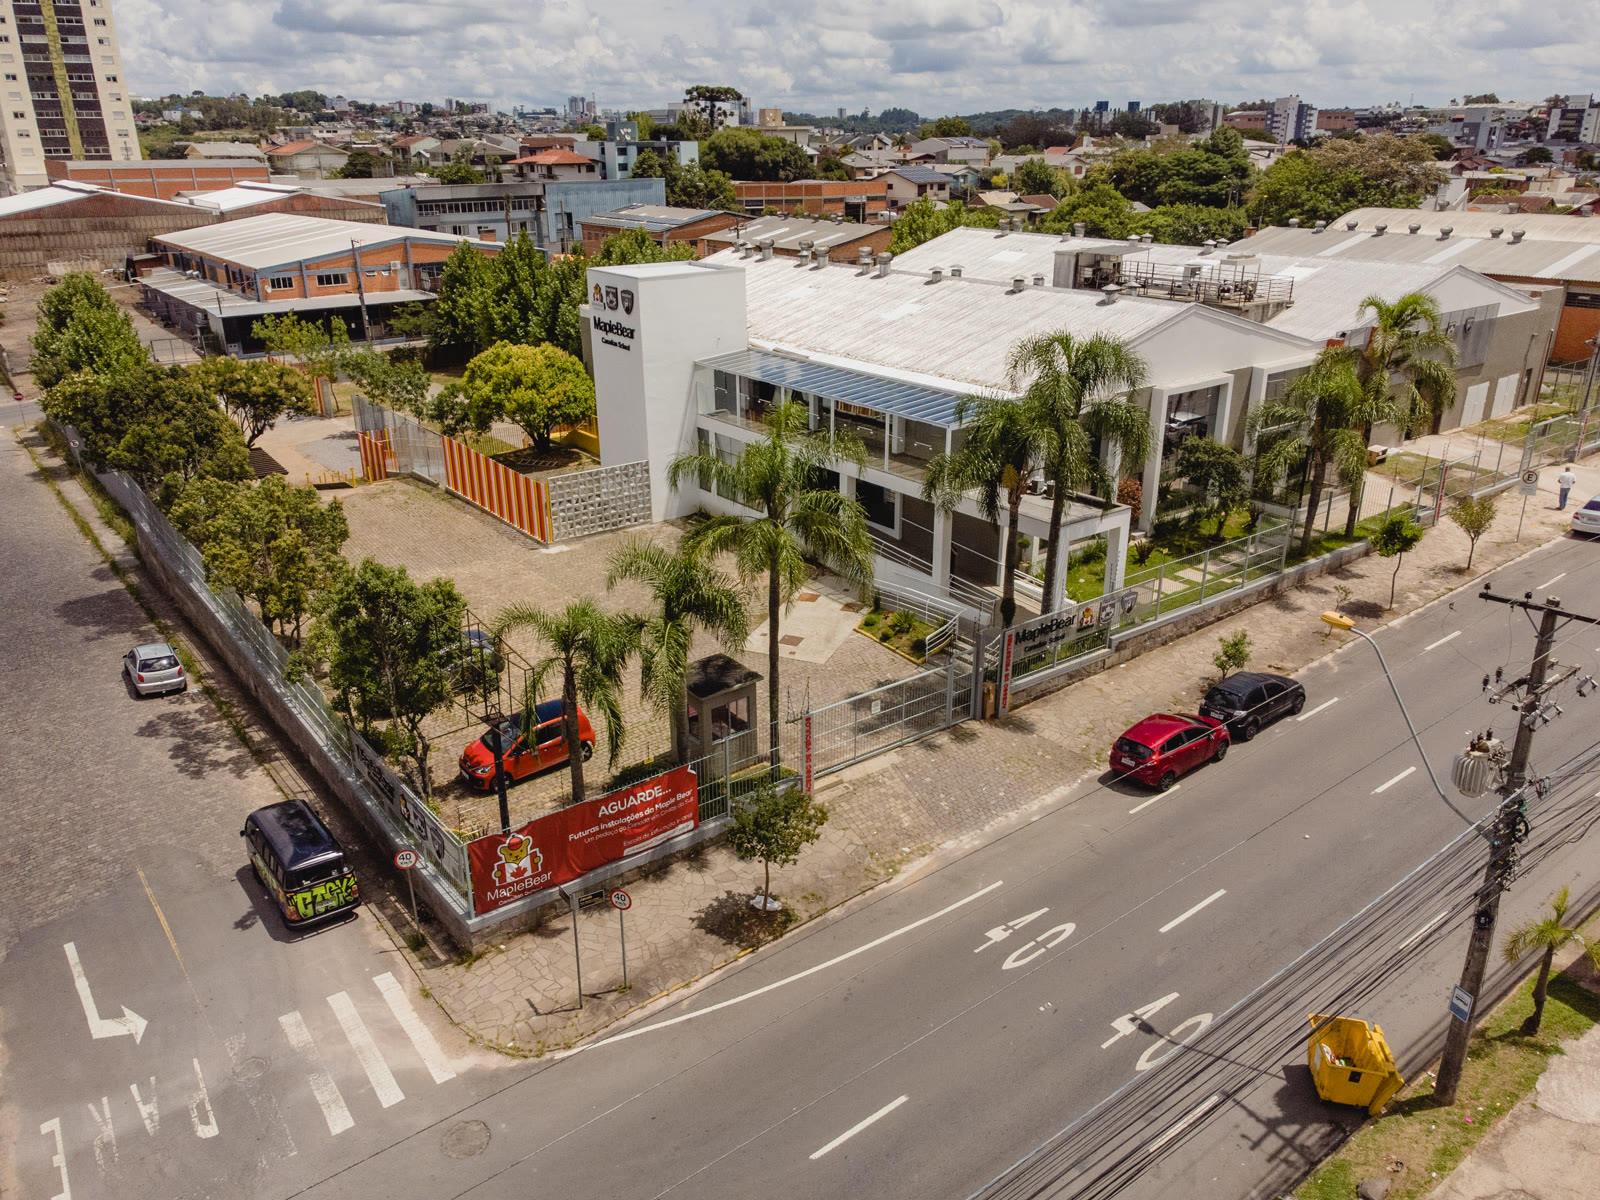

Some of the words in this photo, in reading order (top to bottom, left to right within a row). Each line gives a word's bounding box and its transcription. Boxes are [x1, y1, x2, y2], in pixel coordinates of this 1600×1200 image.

[593, 316, 636, 339] MapleBear
[1014, 614, 1077, 645] MapleBear
[568, 824, 600, 842] Futuras
[655, 797, 676, 812] Maple
[676, 789, 693, 801] Bear
[598, 785, 671, 818] AGUARDE...
[399, 852, 412, 862] 40
[487, 871, 552, 901] MapleBear
[614, 892, 626, 902] 40
[973, 907, 1077, 970] 40
[1100, 991, 1214, 1071] 40
